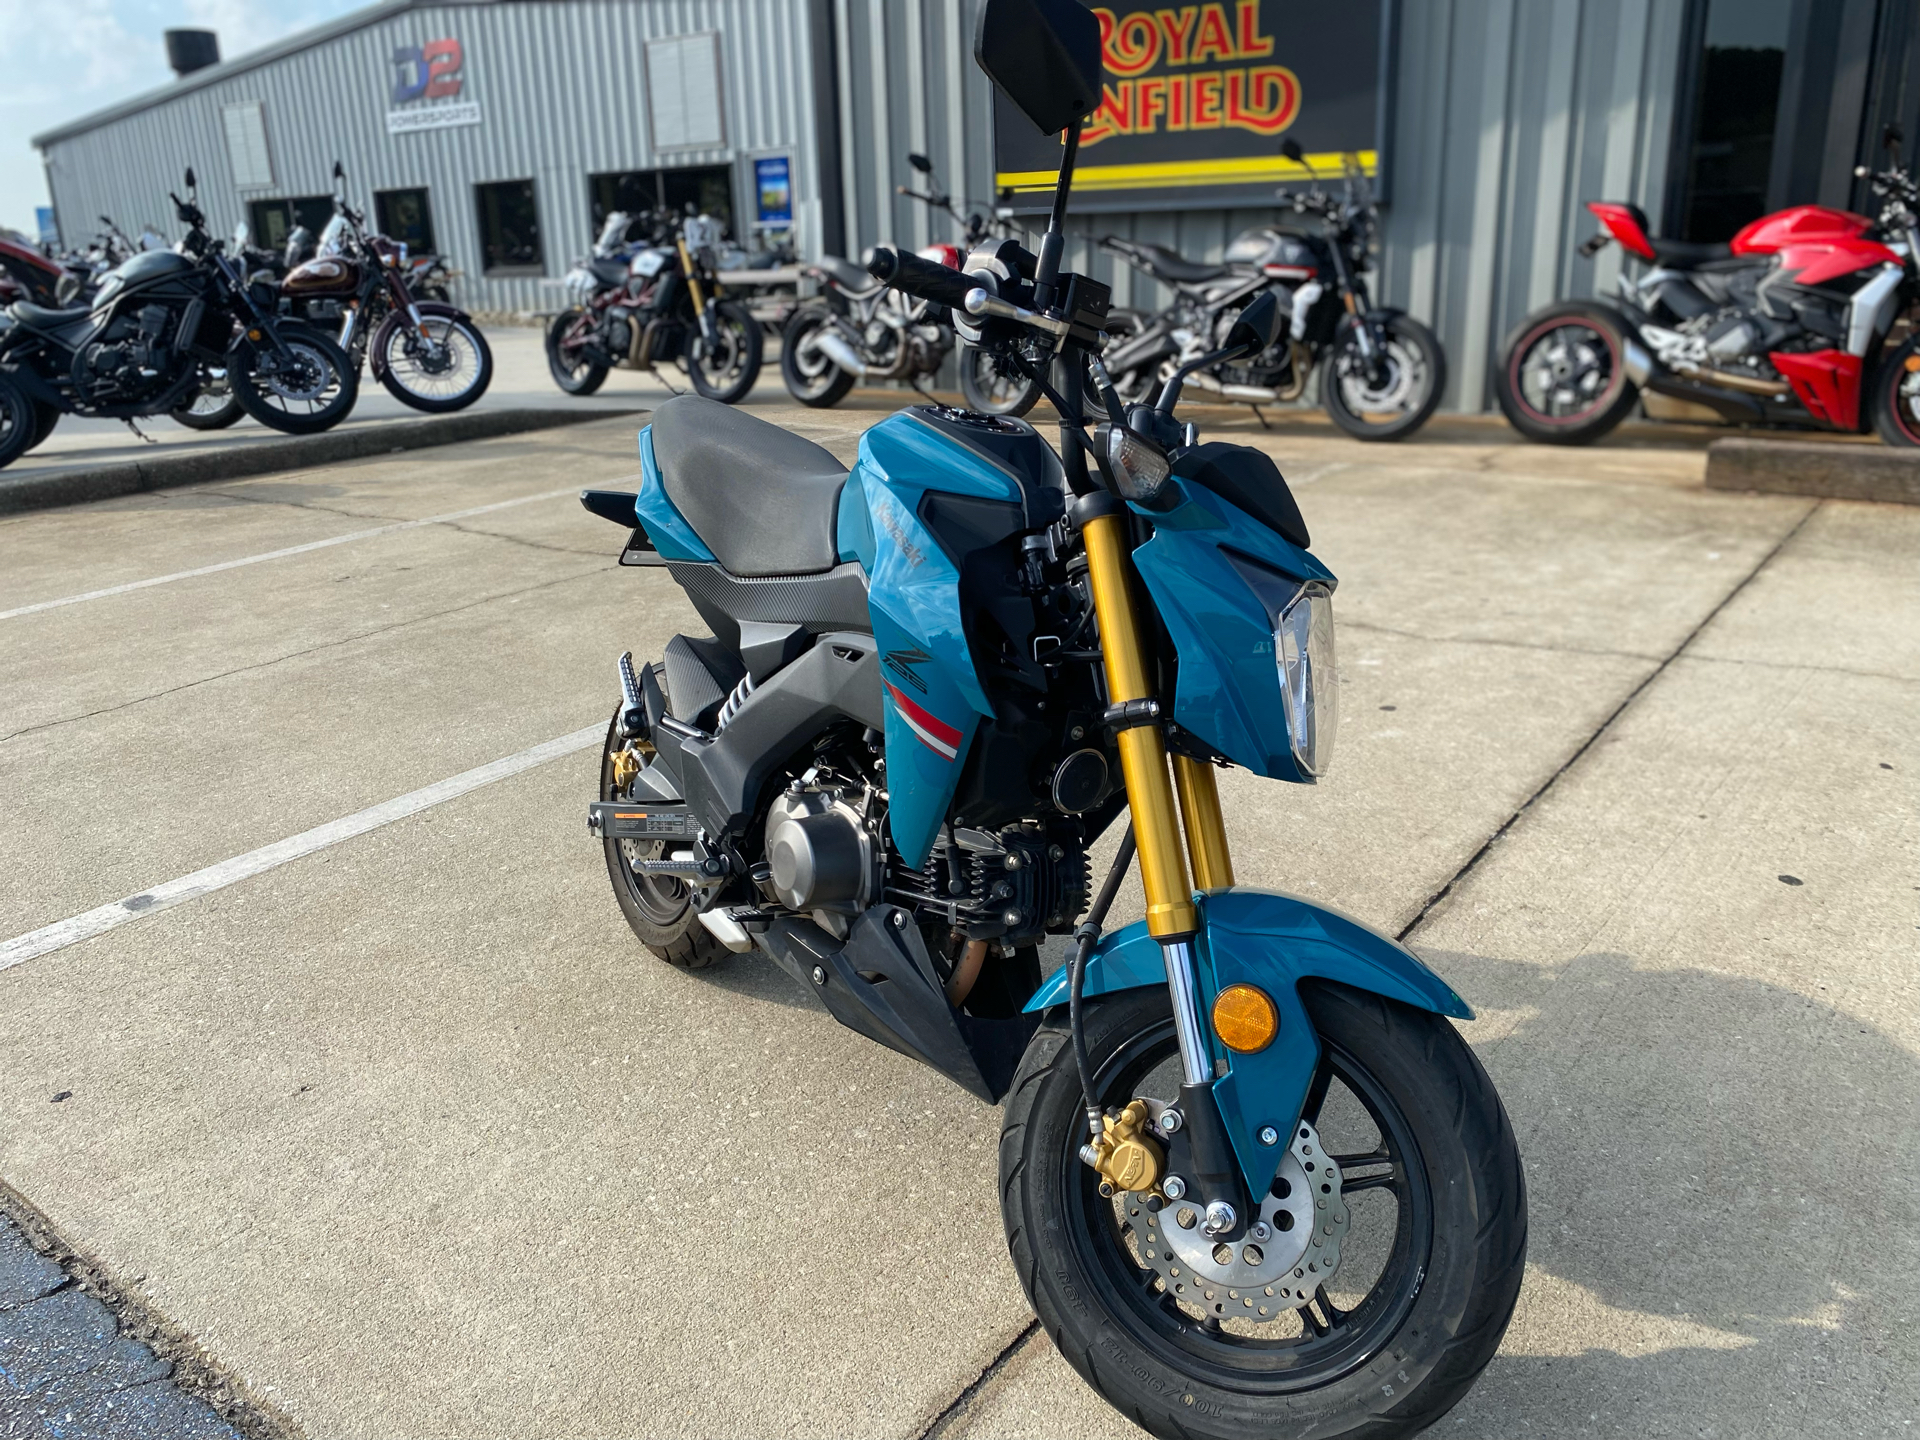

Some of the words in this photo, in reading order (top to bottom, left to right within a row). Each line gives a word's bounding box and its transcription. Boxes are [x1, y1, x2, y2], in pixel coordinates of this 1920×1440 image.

[393, 37, 464, 103] D2
[1061, 65, 1301, 147] NFIELD
[875, 502, 928, 569] Kawasaki
[882, 655, 928, 695] 125
[1100, 1337, 1224, 1418] 100/90-12
